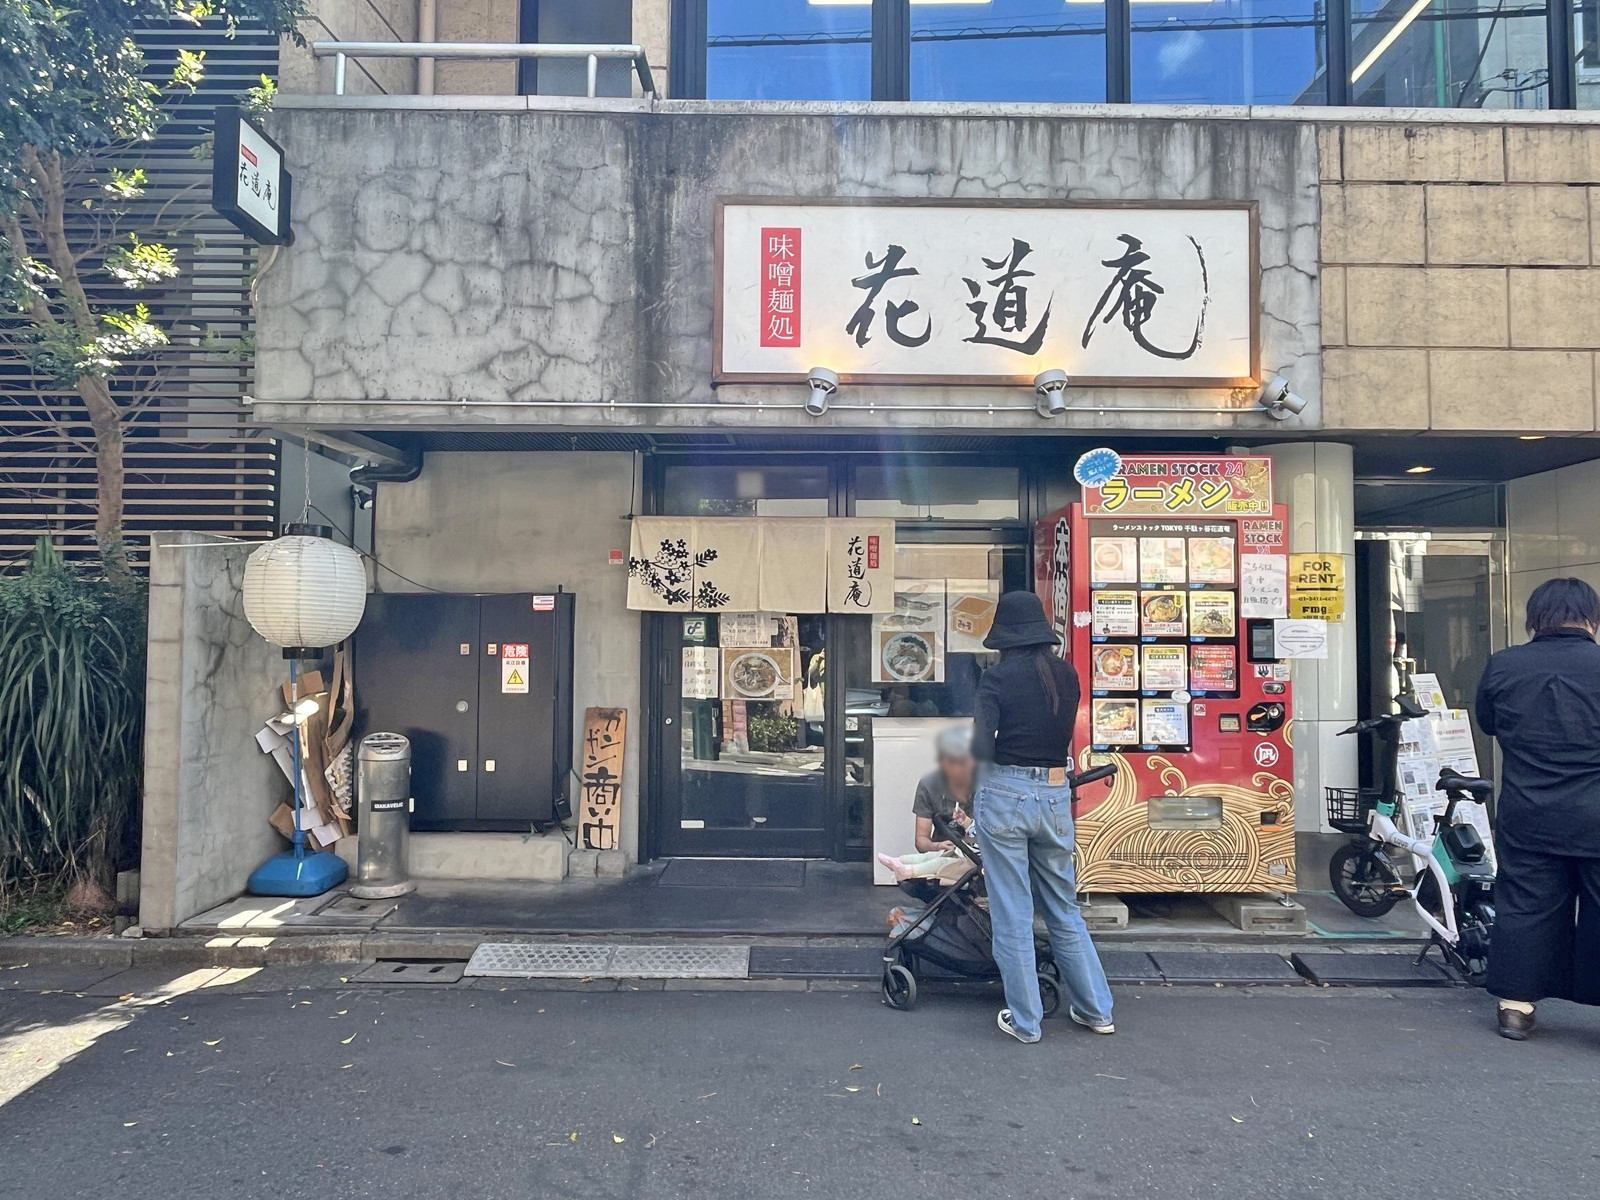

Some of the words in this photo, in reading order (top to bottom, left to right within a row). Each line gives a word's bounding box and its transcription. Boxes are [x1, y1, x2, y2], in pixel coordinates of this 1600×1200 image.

[240, 161, 277, 211] 花道庵
[768, 233, 795, 341] 味噌麺処
[845, 232, 1212, 360] 花道庵
[1118, 463, 1167, 476] RAMEN
[1171, 463, 1219, 476] STOCK
[1225, 462, 1243, 476] 24
[1101, 478, 1232, 511] ラーメン
[1112, 524, 1160, 532] ラーメンストック
[1161, 524, 1183, 532] TOKYO
[1243, 521, 1283, 530] RAMEN
[1244, 533, 1282, 543] STOCK
[844, 535, 873, 608] 花道庵
[1303, 561, 1331, 571] FOR
[1299, 573, 1336, 583] RENT
[504, 644, 528, 658] 危険
